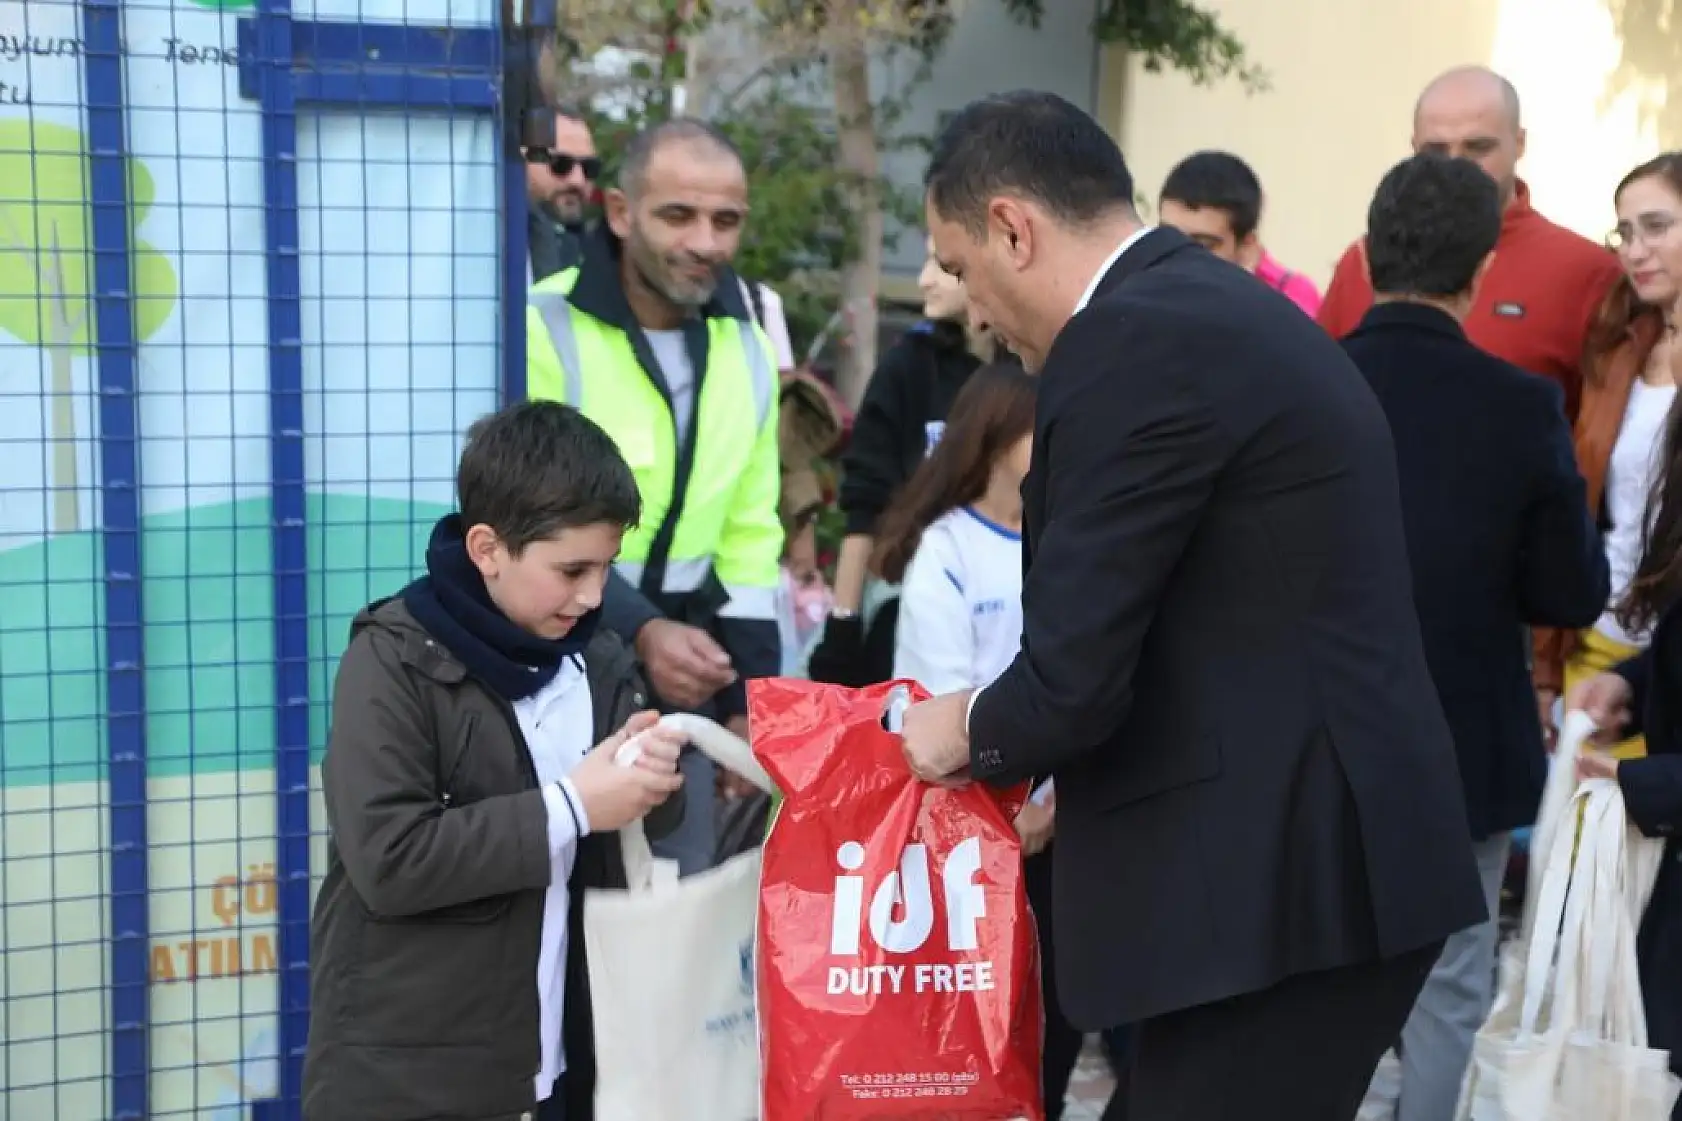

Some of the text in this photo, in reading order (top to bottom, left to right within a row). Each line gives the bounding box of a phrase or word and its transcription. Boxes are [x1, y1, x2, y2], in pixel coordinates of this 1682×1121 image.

[831, 836, 986, 955] idf
[827, 961, 995, 995] DUTY FREE
[862, 1074, 872, 1084] 0
[874, 1073, 893, 1084] 212
